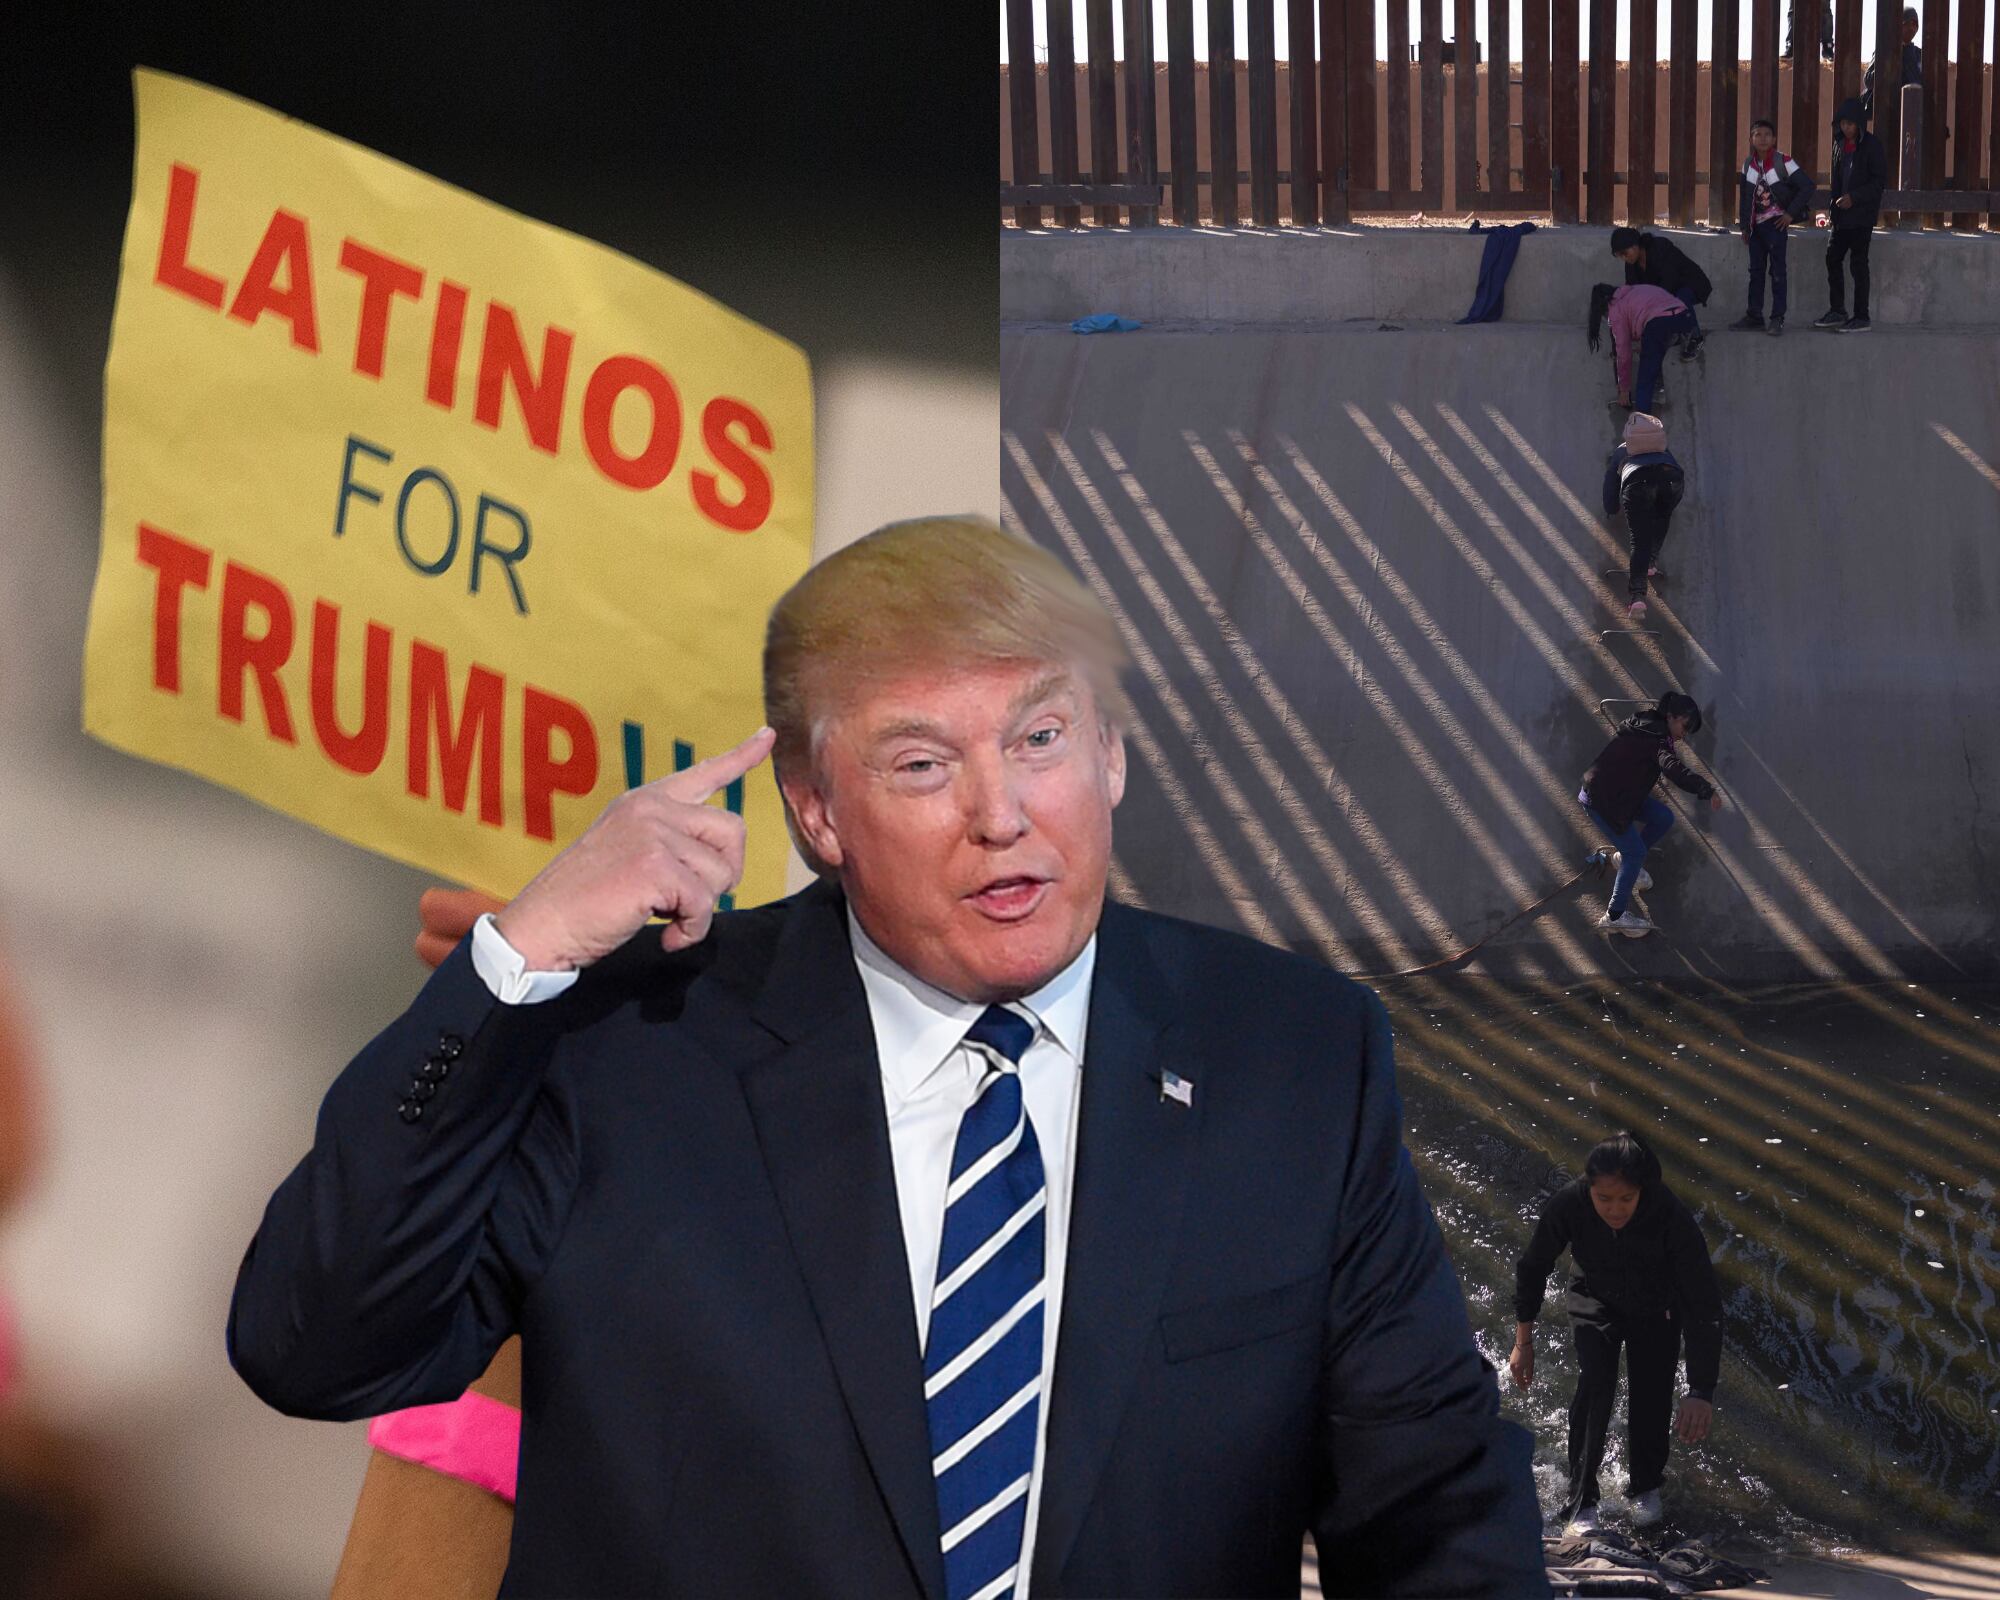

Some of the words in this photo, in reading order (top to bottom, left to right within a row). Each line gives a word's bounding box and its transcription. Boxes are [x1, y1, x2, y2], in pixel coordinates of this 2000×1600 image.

[154, 163, 776, 533] LATINOS
[333, 435, 531, 615] FOR
[136, 522, 744, 912] TRUMP
